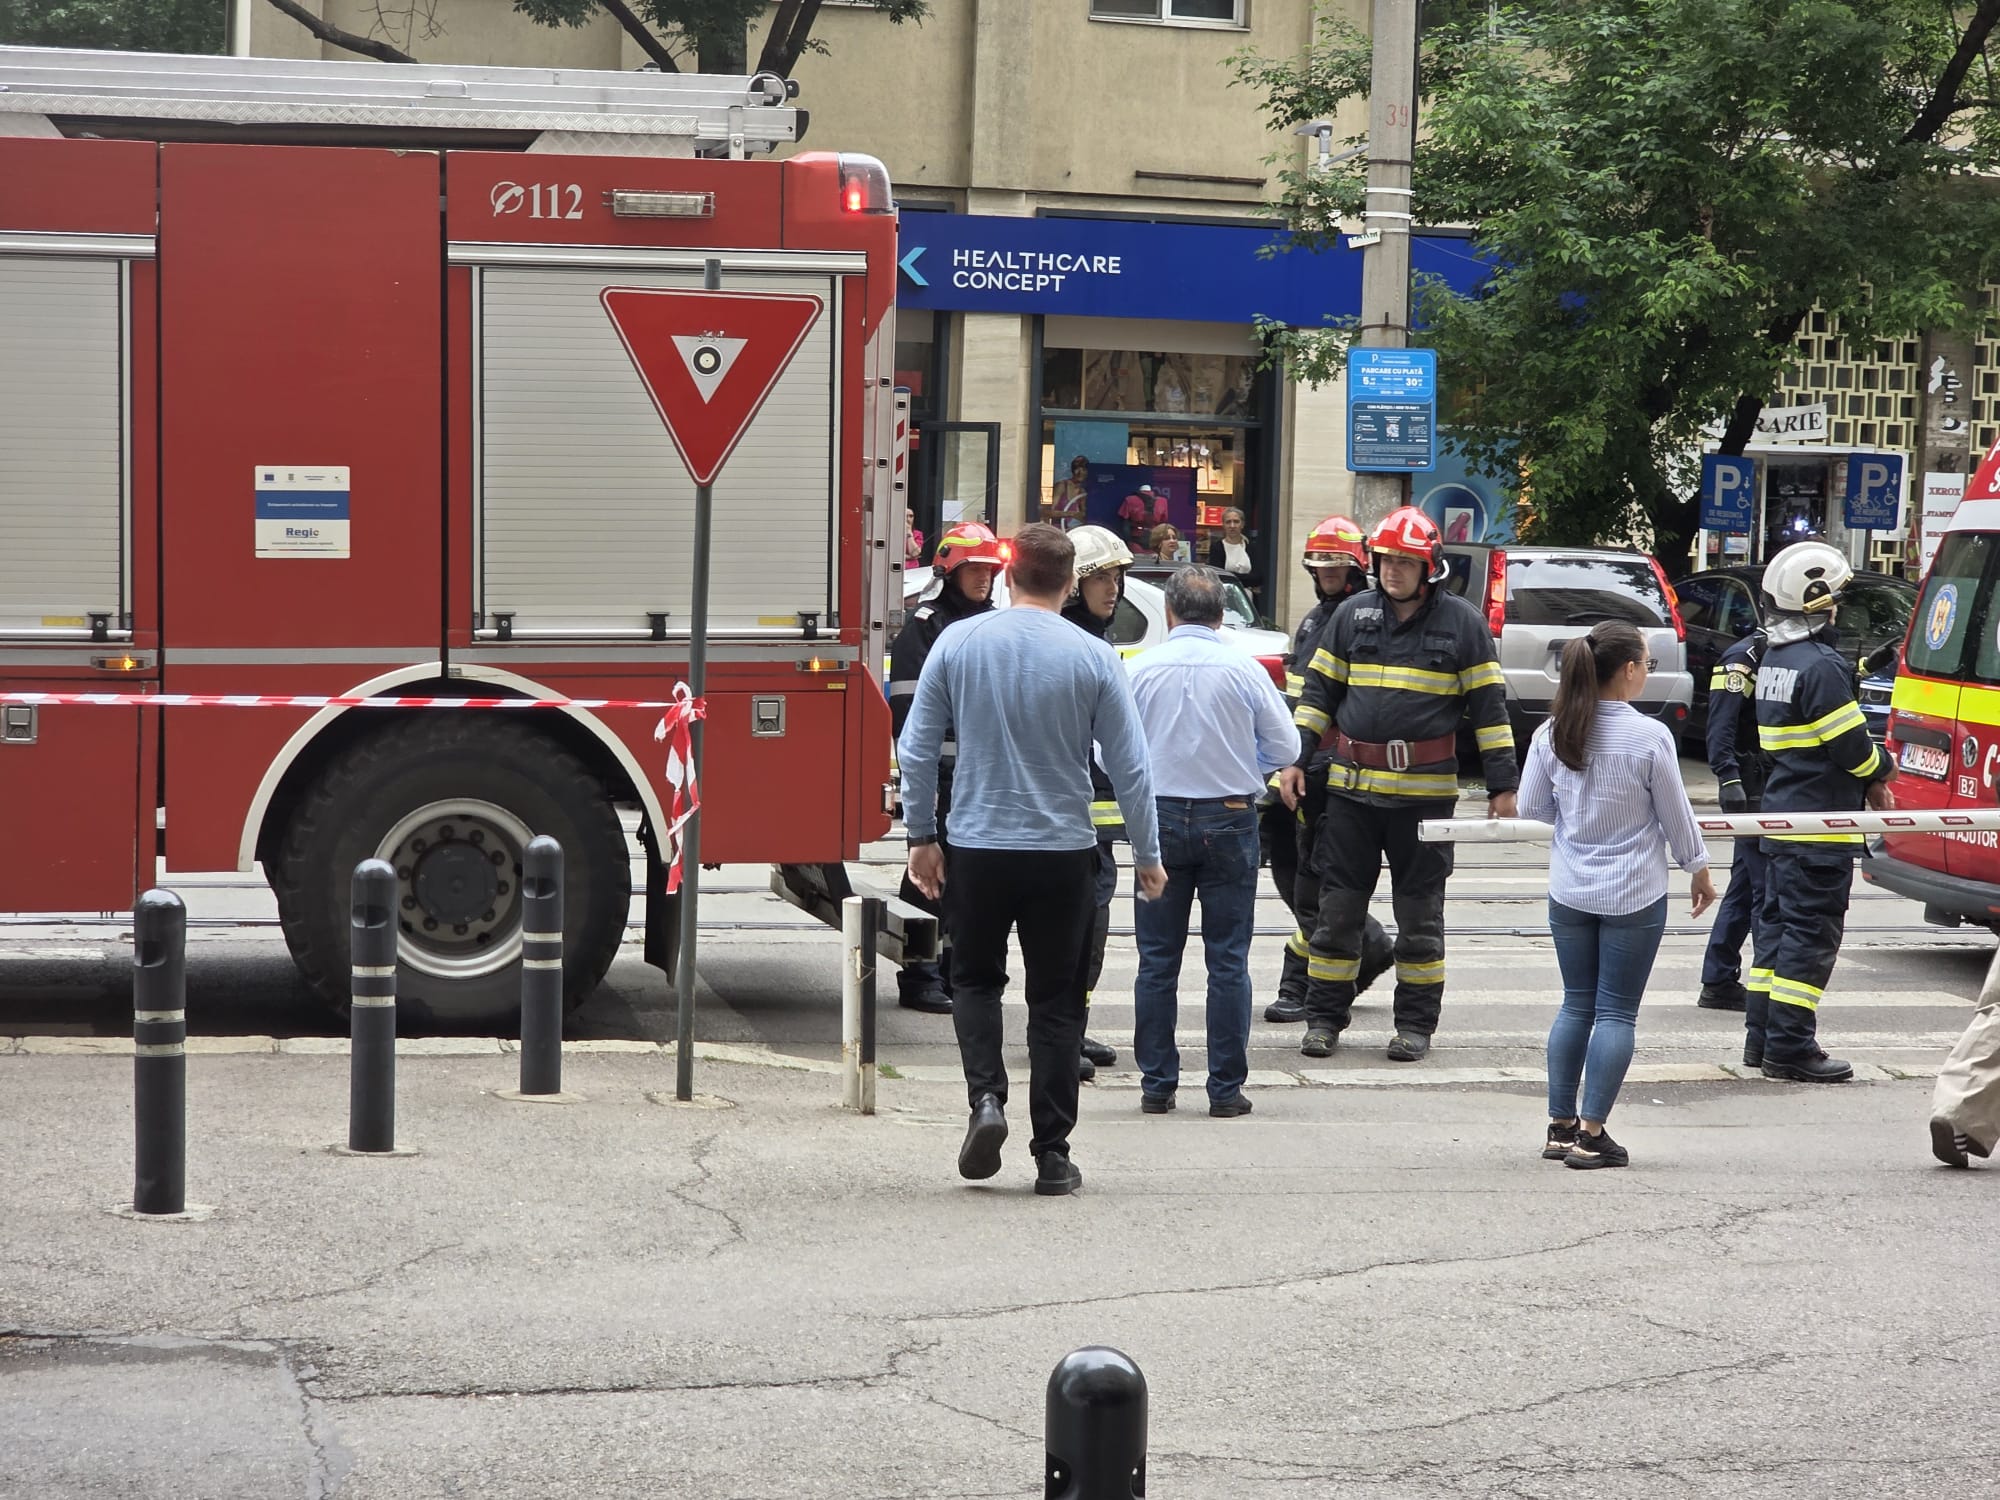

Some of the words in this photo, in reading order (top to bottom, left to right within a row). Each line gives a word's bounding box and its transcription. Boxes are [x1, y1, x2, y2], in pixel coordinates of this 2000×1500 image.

[1385, 103, 1408, 128] 39
[528, 182, 584, 220] 112
[952, 248, 1122, 275] HEALTHCARE
[952, 270, 1066, 293] CONCEPT
[1405, 377, 1418, 387] 30
[1713, 464, 1742, 507] P
[1859, 463, 1889, 505] P
[1928, 486, 1961, 496] XEROX
[1961, 778, 1975, 796] B2
[1956, 830, 1998, 849] AJUTOR
